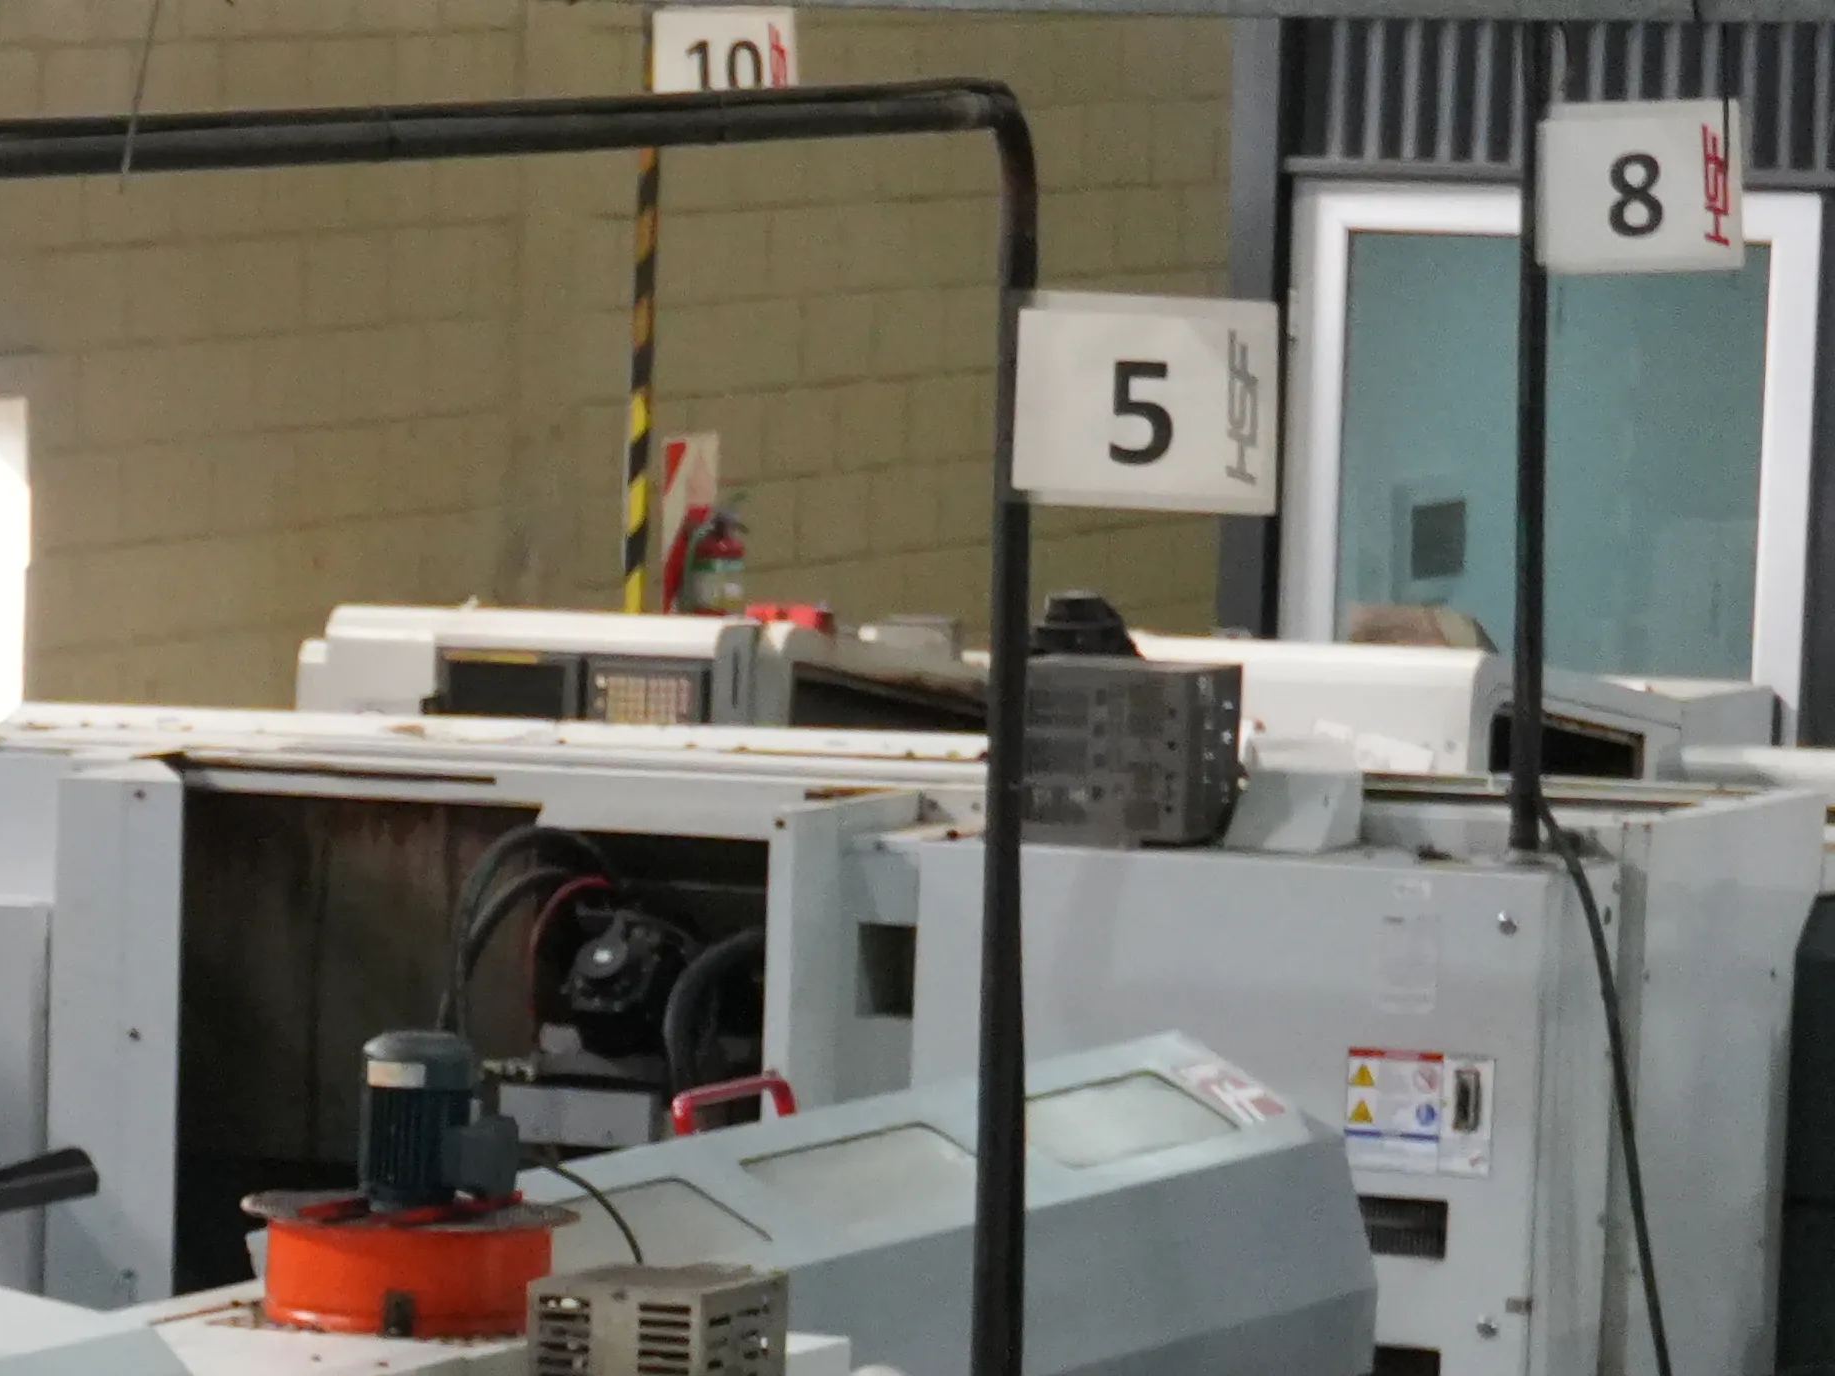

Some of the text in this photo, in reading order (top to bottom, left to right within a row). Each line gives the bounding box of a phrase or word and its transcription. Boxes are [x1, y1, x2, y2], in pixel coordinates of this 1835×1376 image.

[686, 40, 764, 90] 10
[768, 22, 788, 90] SF
[1609, 153, 1663, 237] 8
[1702, 123, 1730, 246] HSF
[1109, 361, 1173, 465] 5
[1225, 328, 1259, 485] HSF
